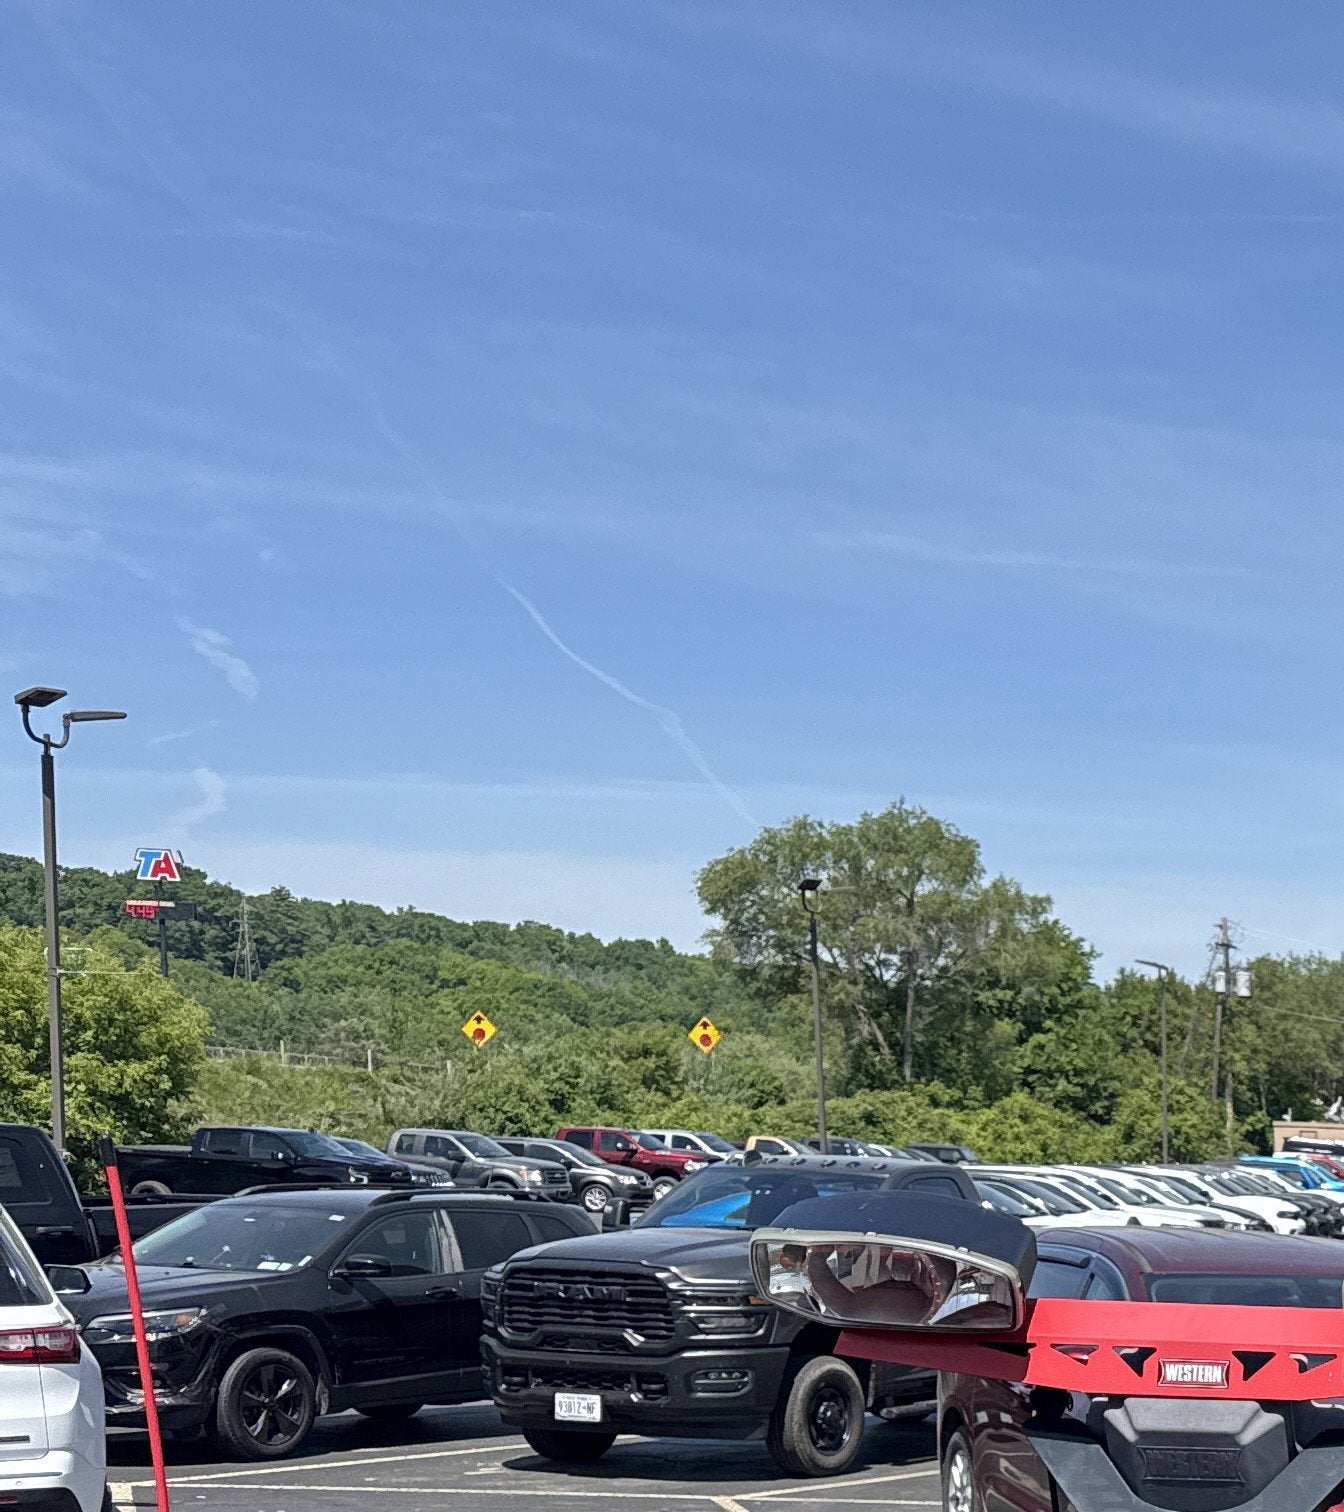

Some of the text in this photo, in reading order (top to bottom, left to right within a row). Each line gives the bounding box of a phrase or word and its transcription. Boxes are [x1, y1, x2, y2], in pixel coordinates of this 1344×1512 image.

[135, 849, 180, 881] TA
[1165, 1364, 1221, 1382] WESTERN
[1145, 1450, 1236, 1476] WESTERN
